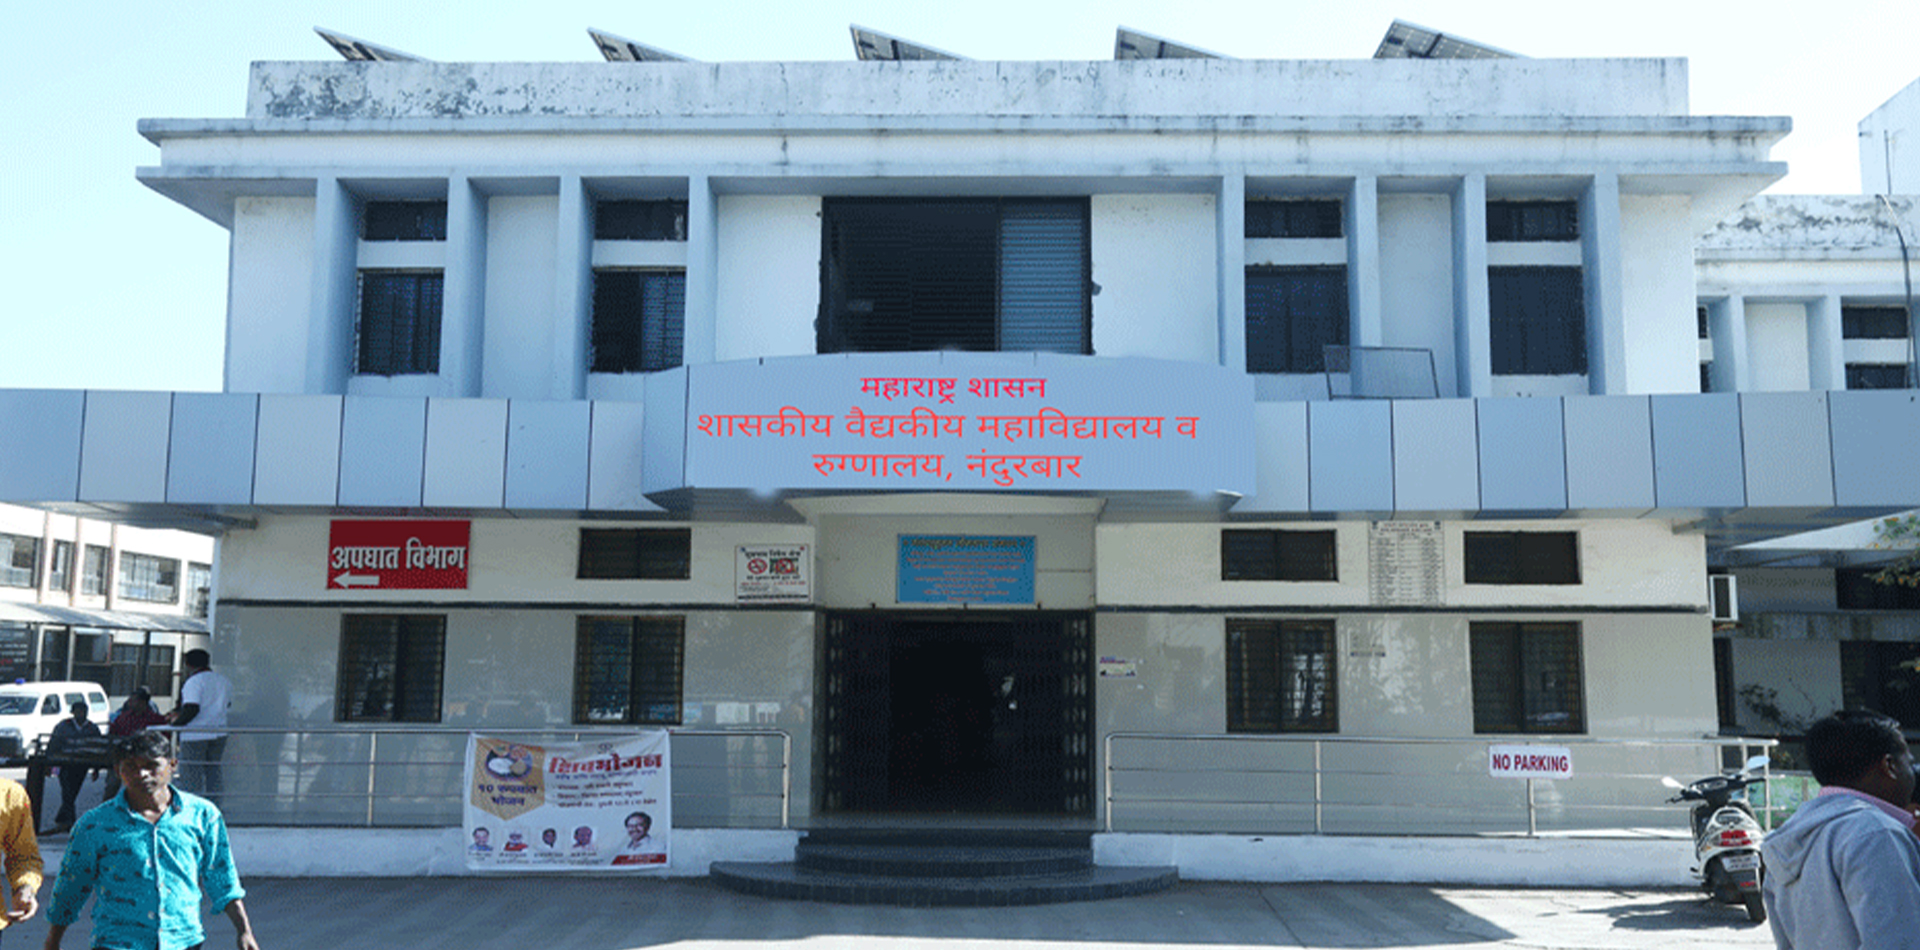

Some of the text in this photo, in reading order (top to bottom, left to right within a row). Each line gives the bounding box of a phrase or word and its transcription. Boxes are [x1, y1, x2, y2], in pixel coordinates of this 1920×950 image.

[860, 377, 1047, 404] महाराष्ट्र शासन
[697, 406, 1200, 441] शासकीय वैद्यकीय महाविद्यालय व
[812, 448, 1083, 486] रुग्णालय, नंदुरबार
[331, 537, 466, 569] अपघात विभाग
[1492, 754, 1569, 772] NO PARKING
